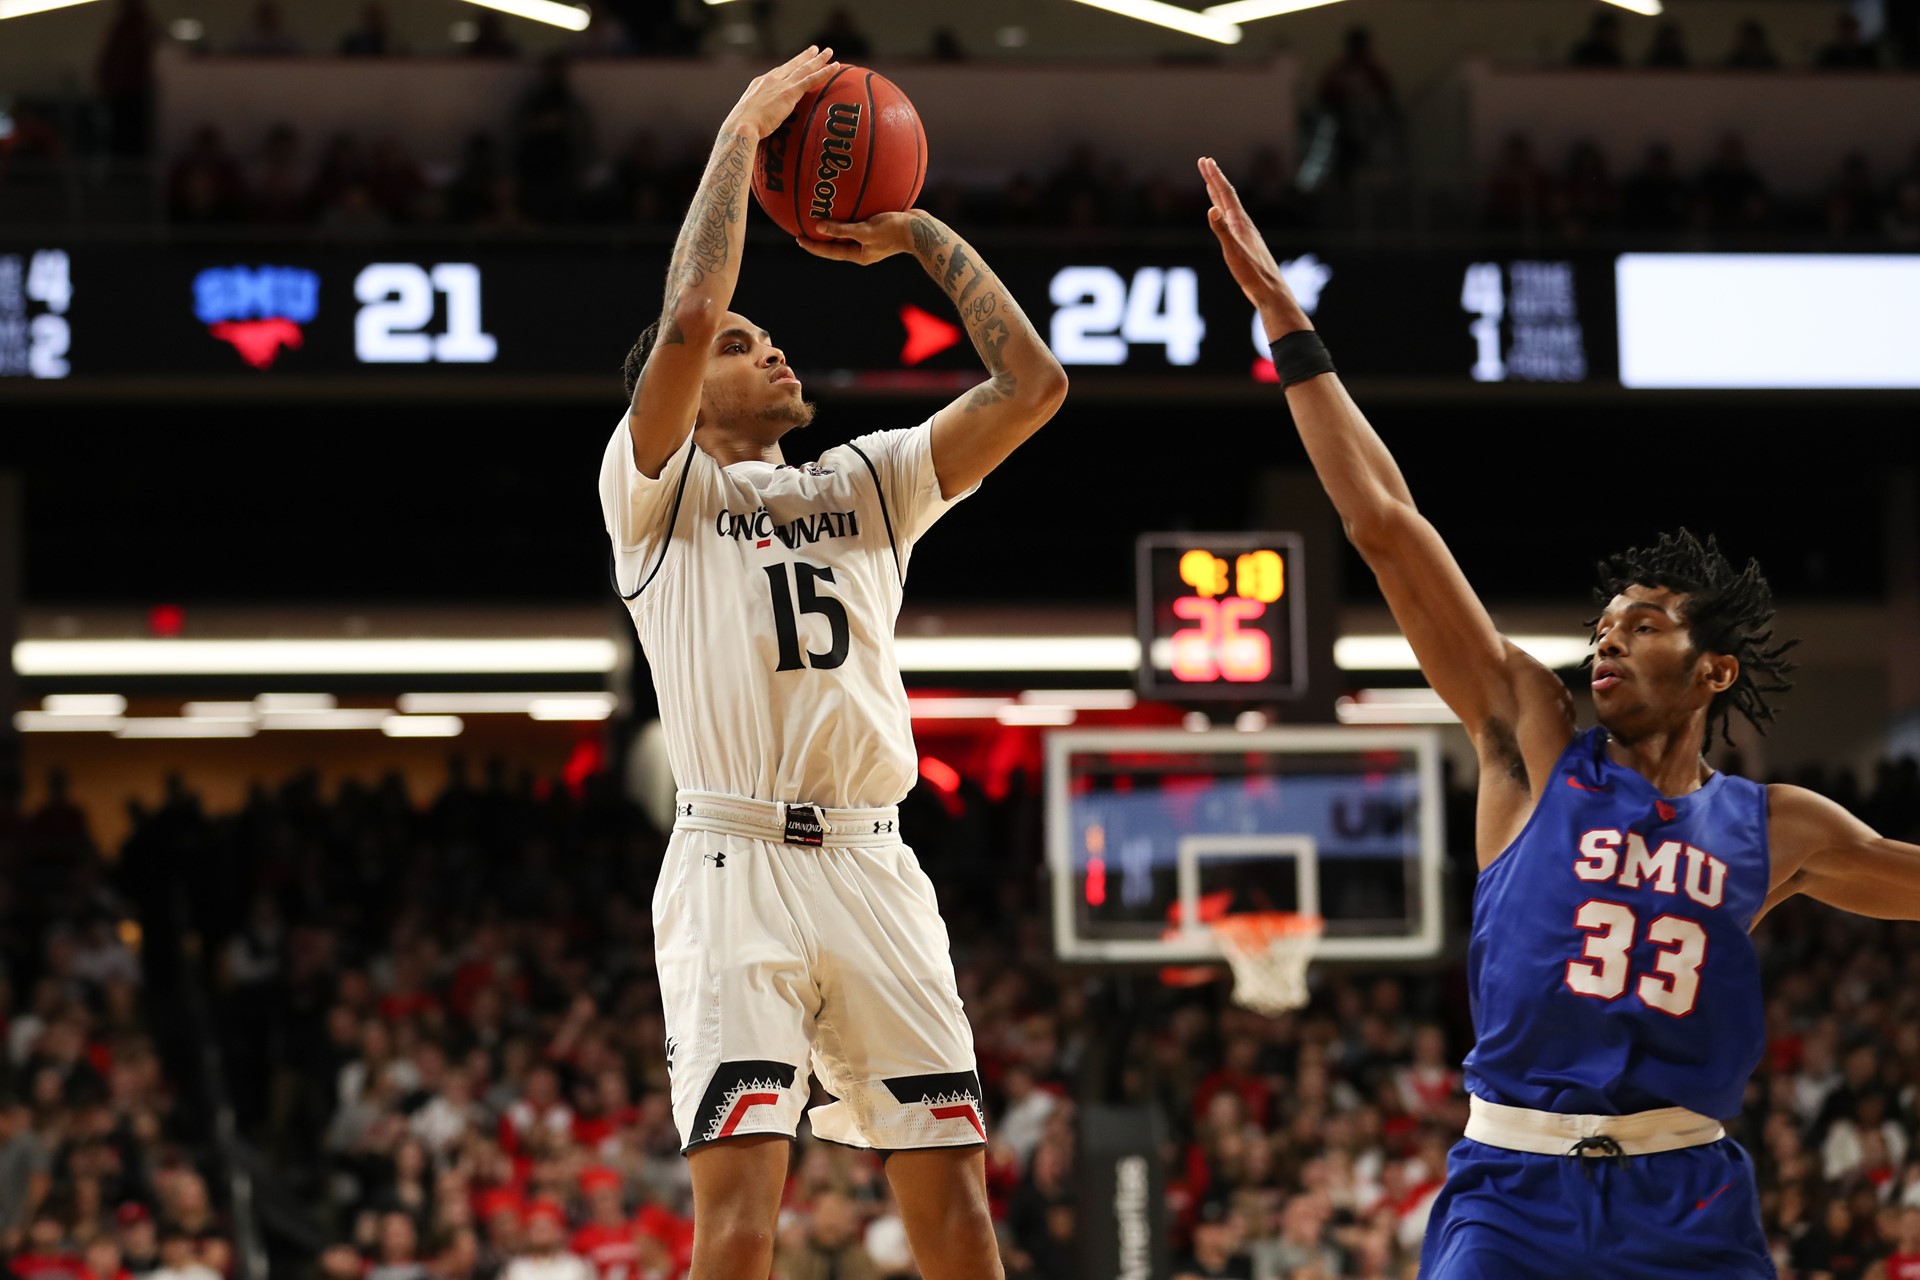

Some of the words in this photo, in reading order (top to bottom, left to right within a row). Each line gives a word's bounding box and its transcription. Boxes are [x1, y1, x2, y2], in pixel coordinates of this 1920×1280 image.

[809, 102, 862, 220] Wilson
[29, 312, 72, 379] 2
[355, 263, 497, 363] 21
[1048, 265, 1206, 366] 24
[1468, 318, 1508, 383] 1
[763, 561, 850, 672] 15
[1573, 828, 1728, 909] SMU
[1563, 897, 1710, 1019] 33
